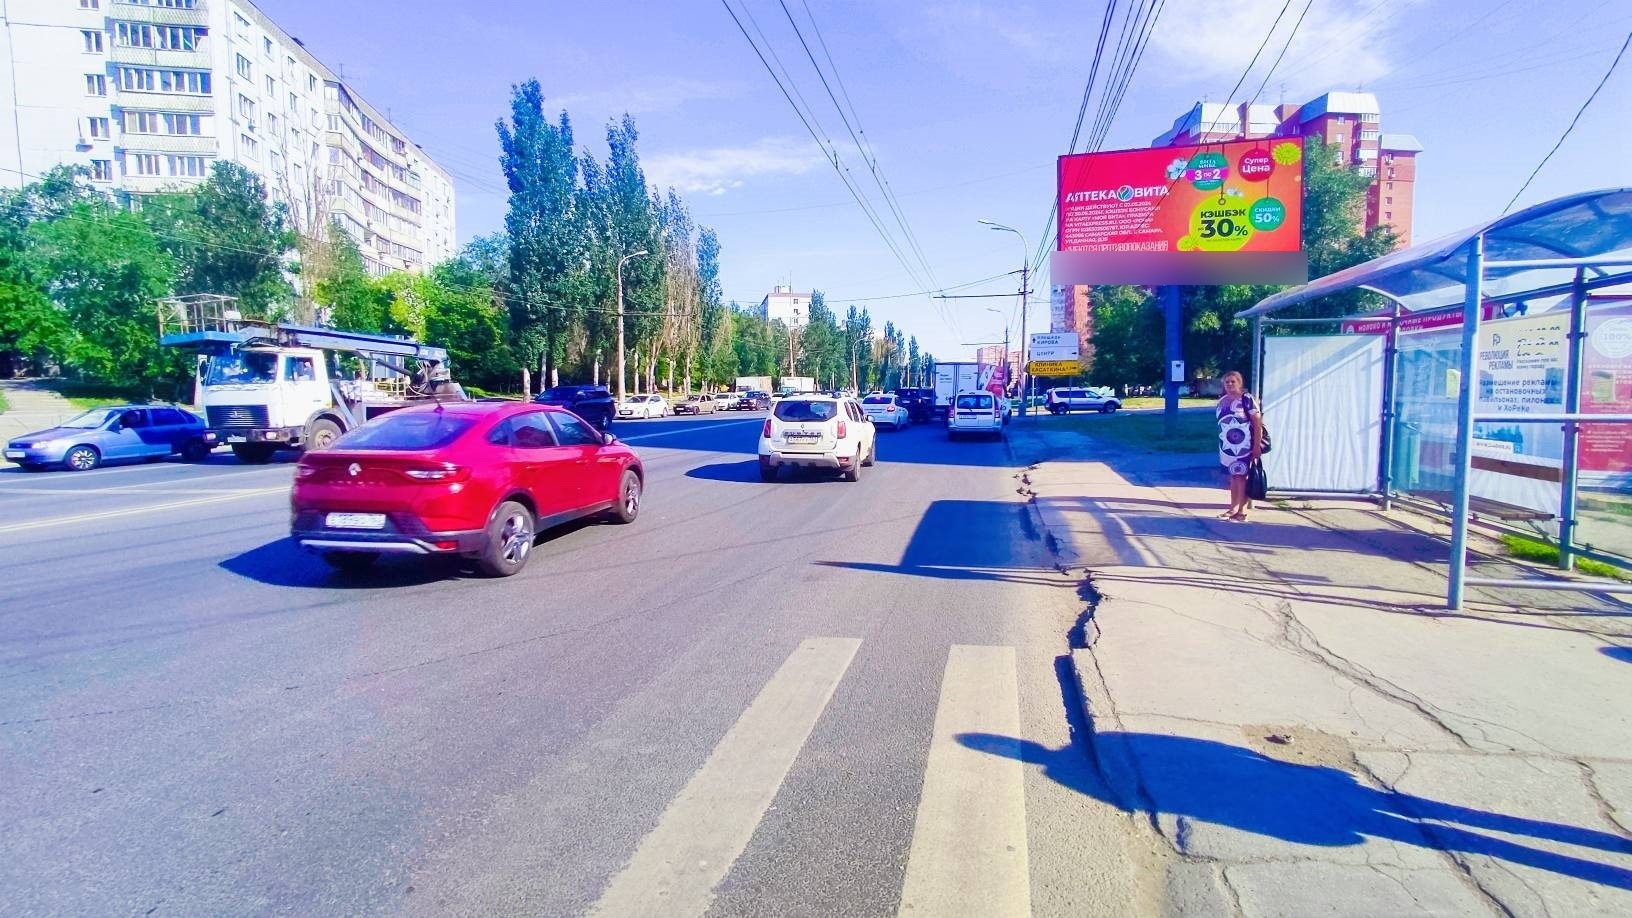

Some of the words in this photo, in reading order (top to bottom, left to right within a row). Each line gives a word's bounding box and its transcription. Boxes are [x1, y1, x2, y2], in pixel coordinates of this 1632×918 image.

[1244, 157, 1269, 165] Супер
[1242, 165, 1270, 173] Цена
[1194, 170, 1202, 180] 3
[1212, 169, 1221, 180] 2
[1065, 190, 1117, 203] АПТЕКА
[1134, 185, 1169, 198] ВИТА
[1200, 208, 1247, 218] КЭШБЭК
[1254, 213, 1280, 223] 50%
[1200, 218, 1248, 238] 30%
